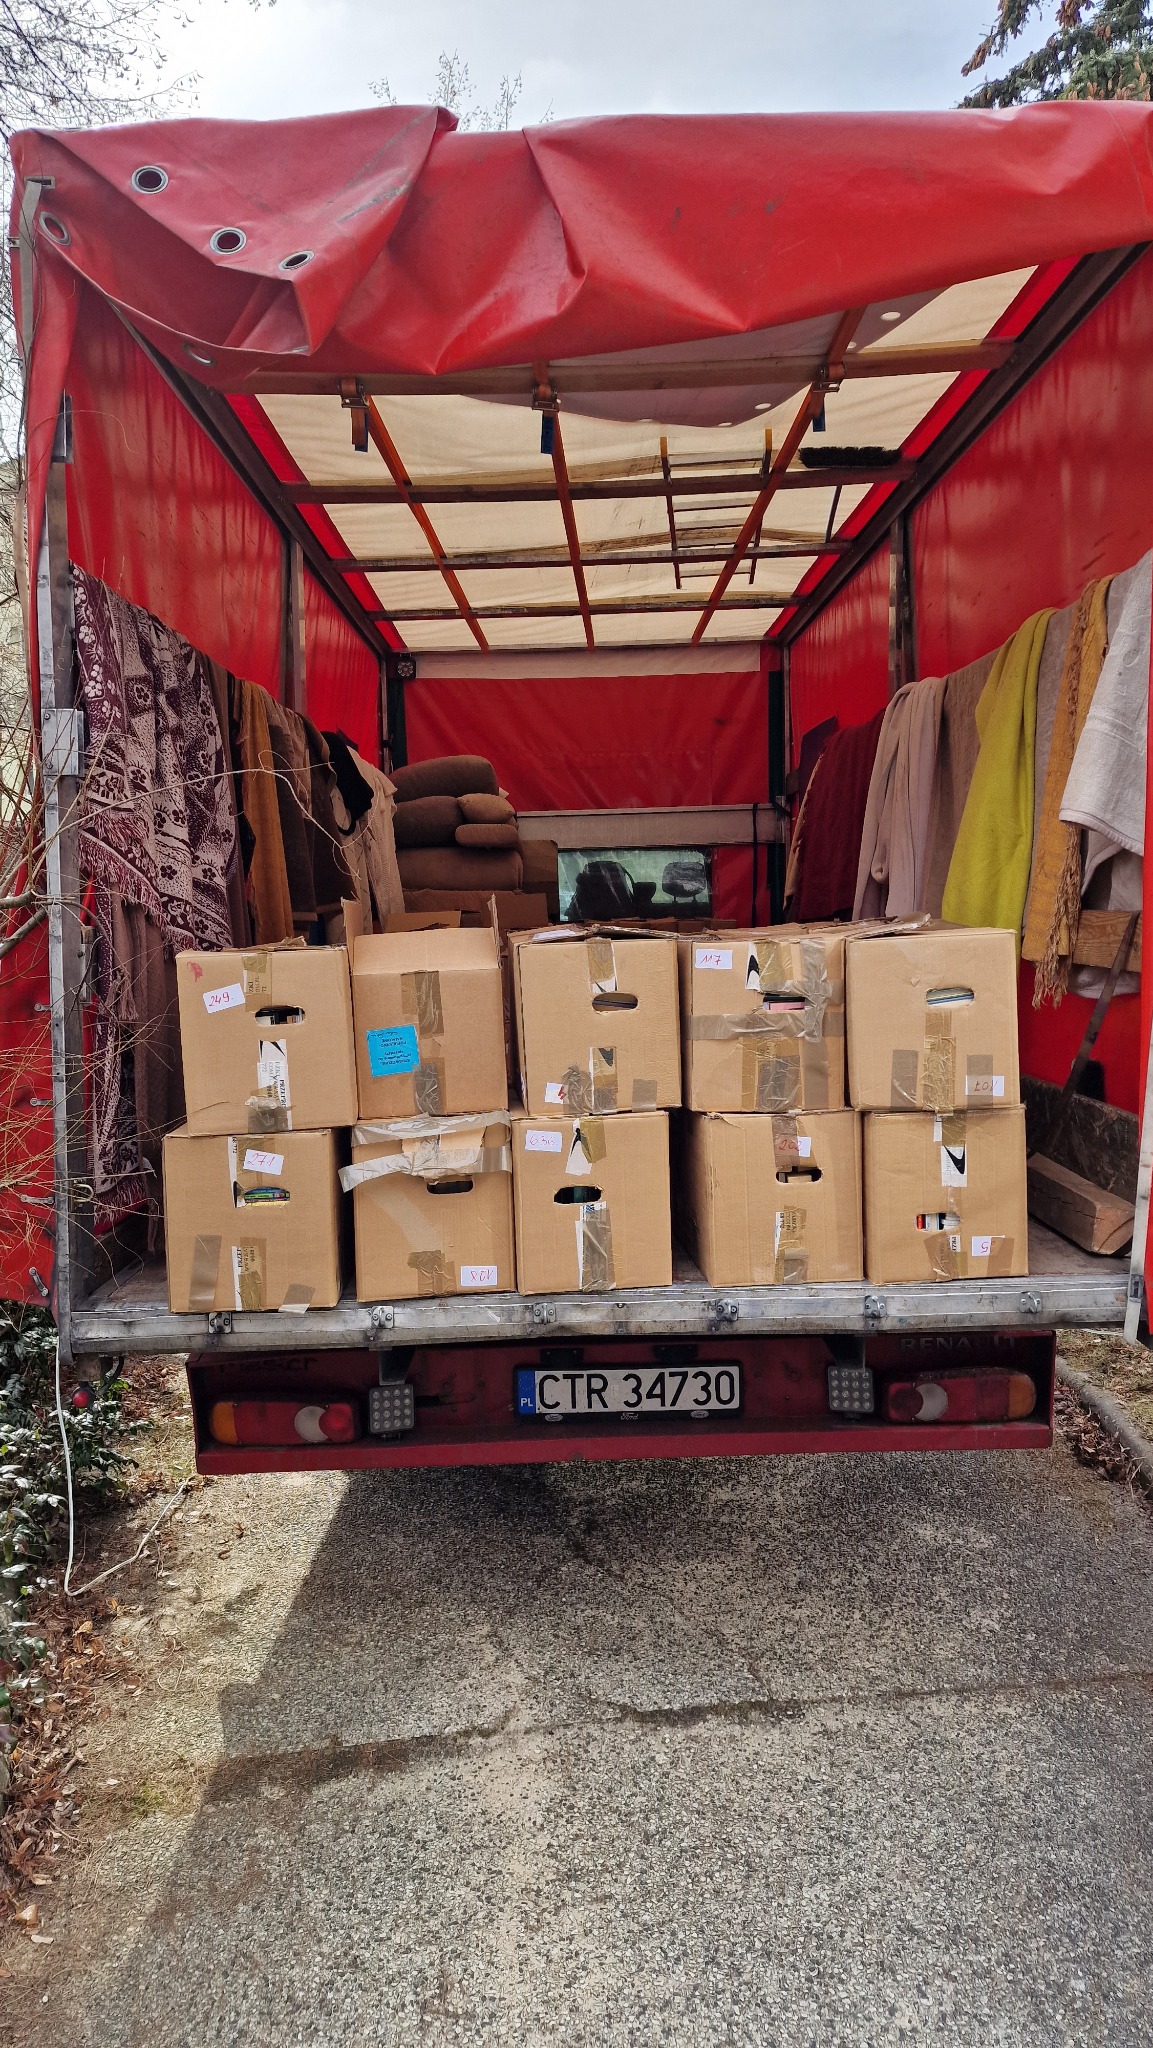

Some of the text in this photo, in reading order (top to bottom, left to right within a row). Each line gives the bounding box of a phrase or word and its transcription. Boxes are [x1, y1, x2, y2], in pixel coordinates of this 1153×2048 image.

[700, 954, 723, 966] 117
[247, 1151, 275, 1168] 271
[538, 1371, 736, 1410] CTR 34730
[520, 1398, 534, 1407] PL
